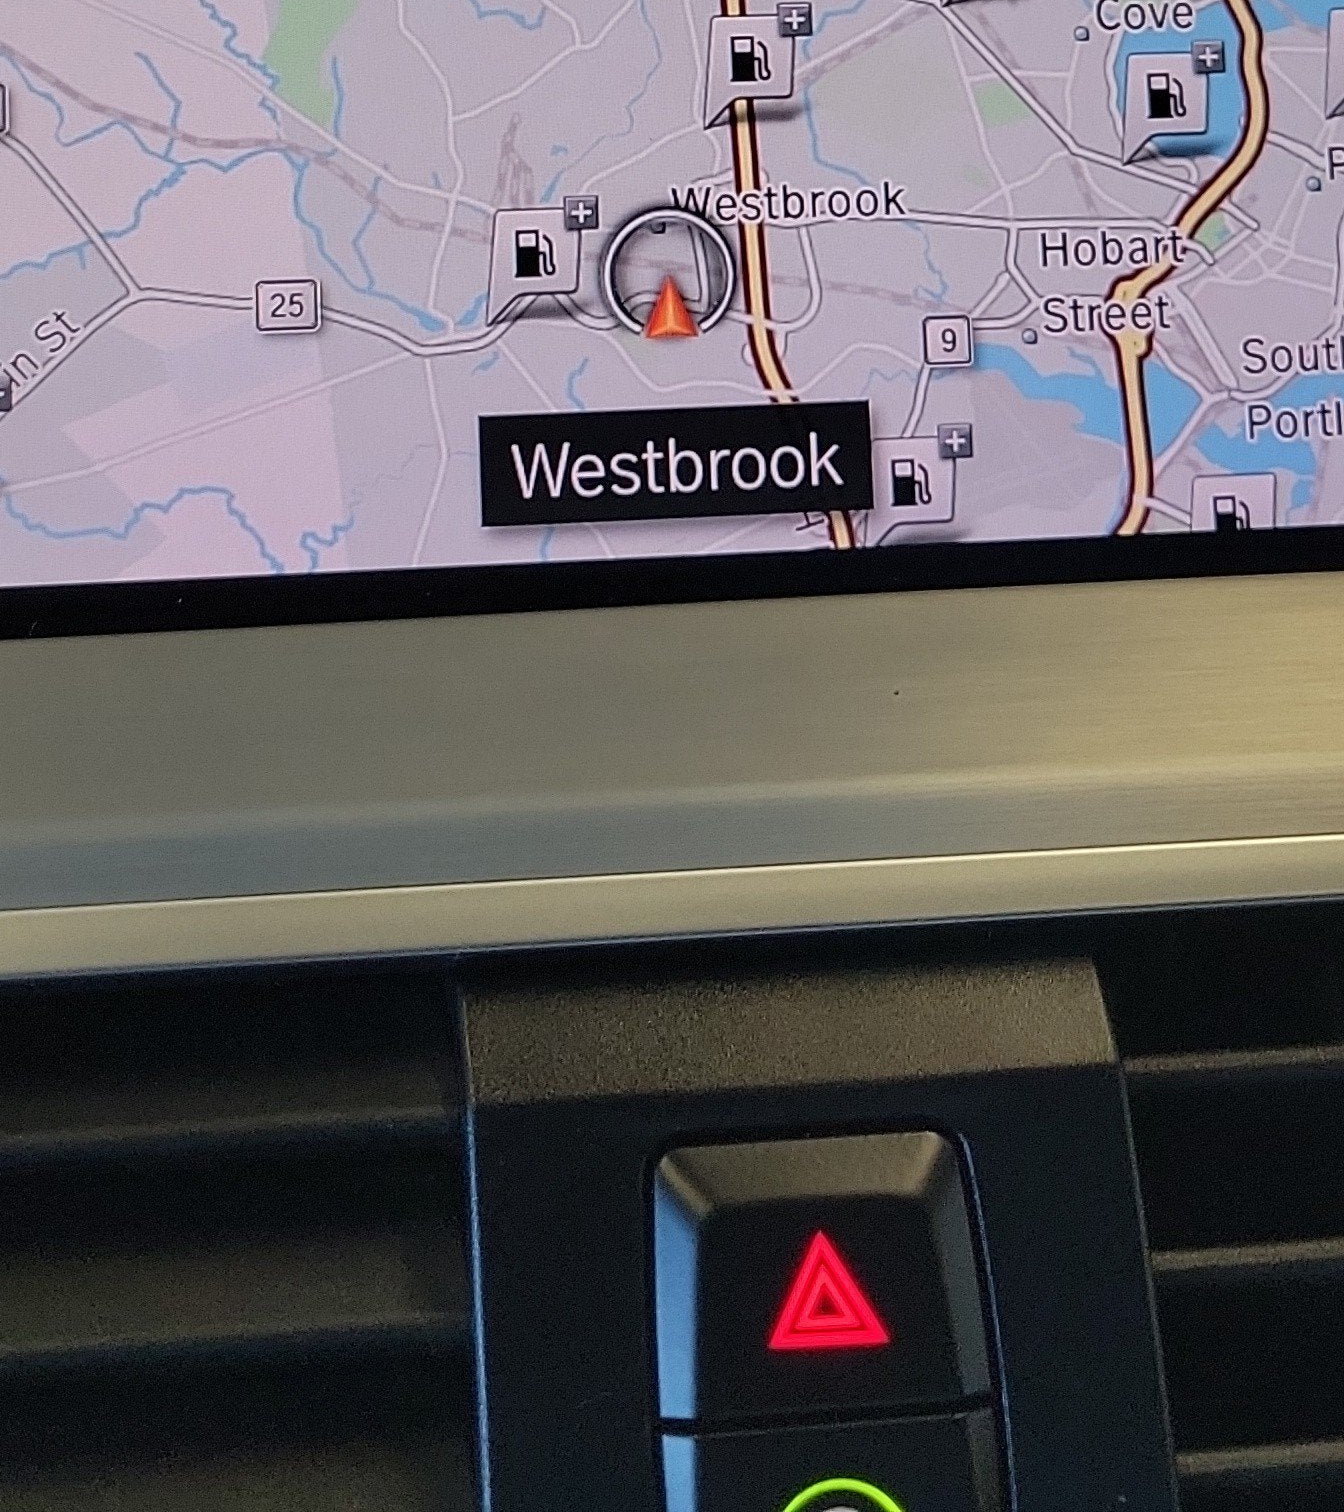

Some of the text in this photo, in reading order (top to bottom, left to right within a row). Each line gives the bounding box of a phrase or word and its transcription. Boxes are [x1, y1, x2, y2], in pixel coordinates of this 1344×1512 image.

[672, 183, 906, 222] Westbrook
[1040, 230, 1184, 267] Hobart
[269, 294, 304, 319] 25
[1043, 296, 1170, 332] Street
[35, 311, 81, 352] St
[941, 330, 956, 352] 9
[511, 431, 844, 500] Westbrook
